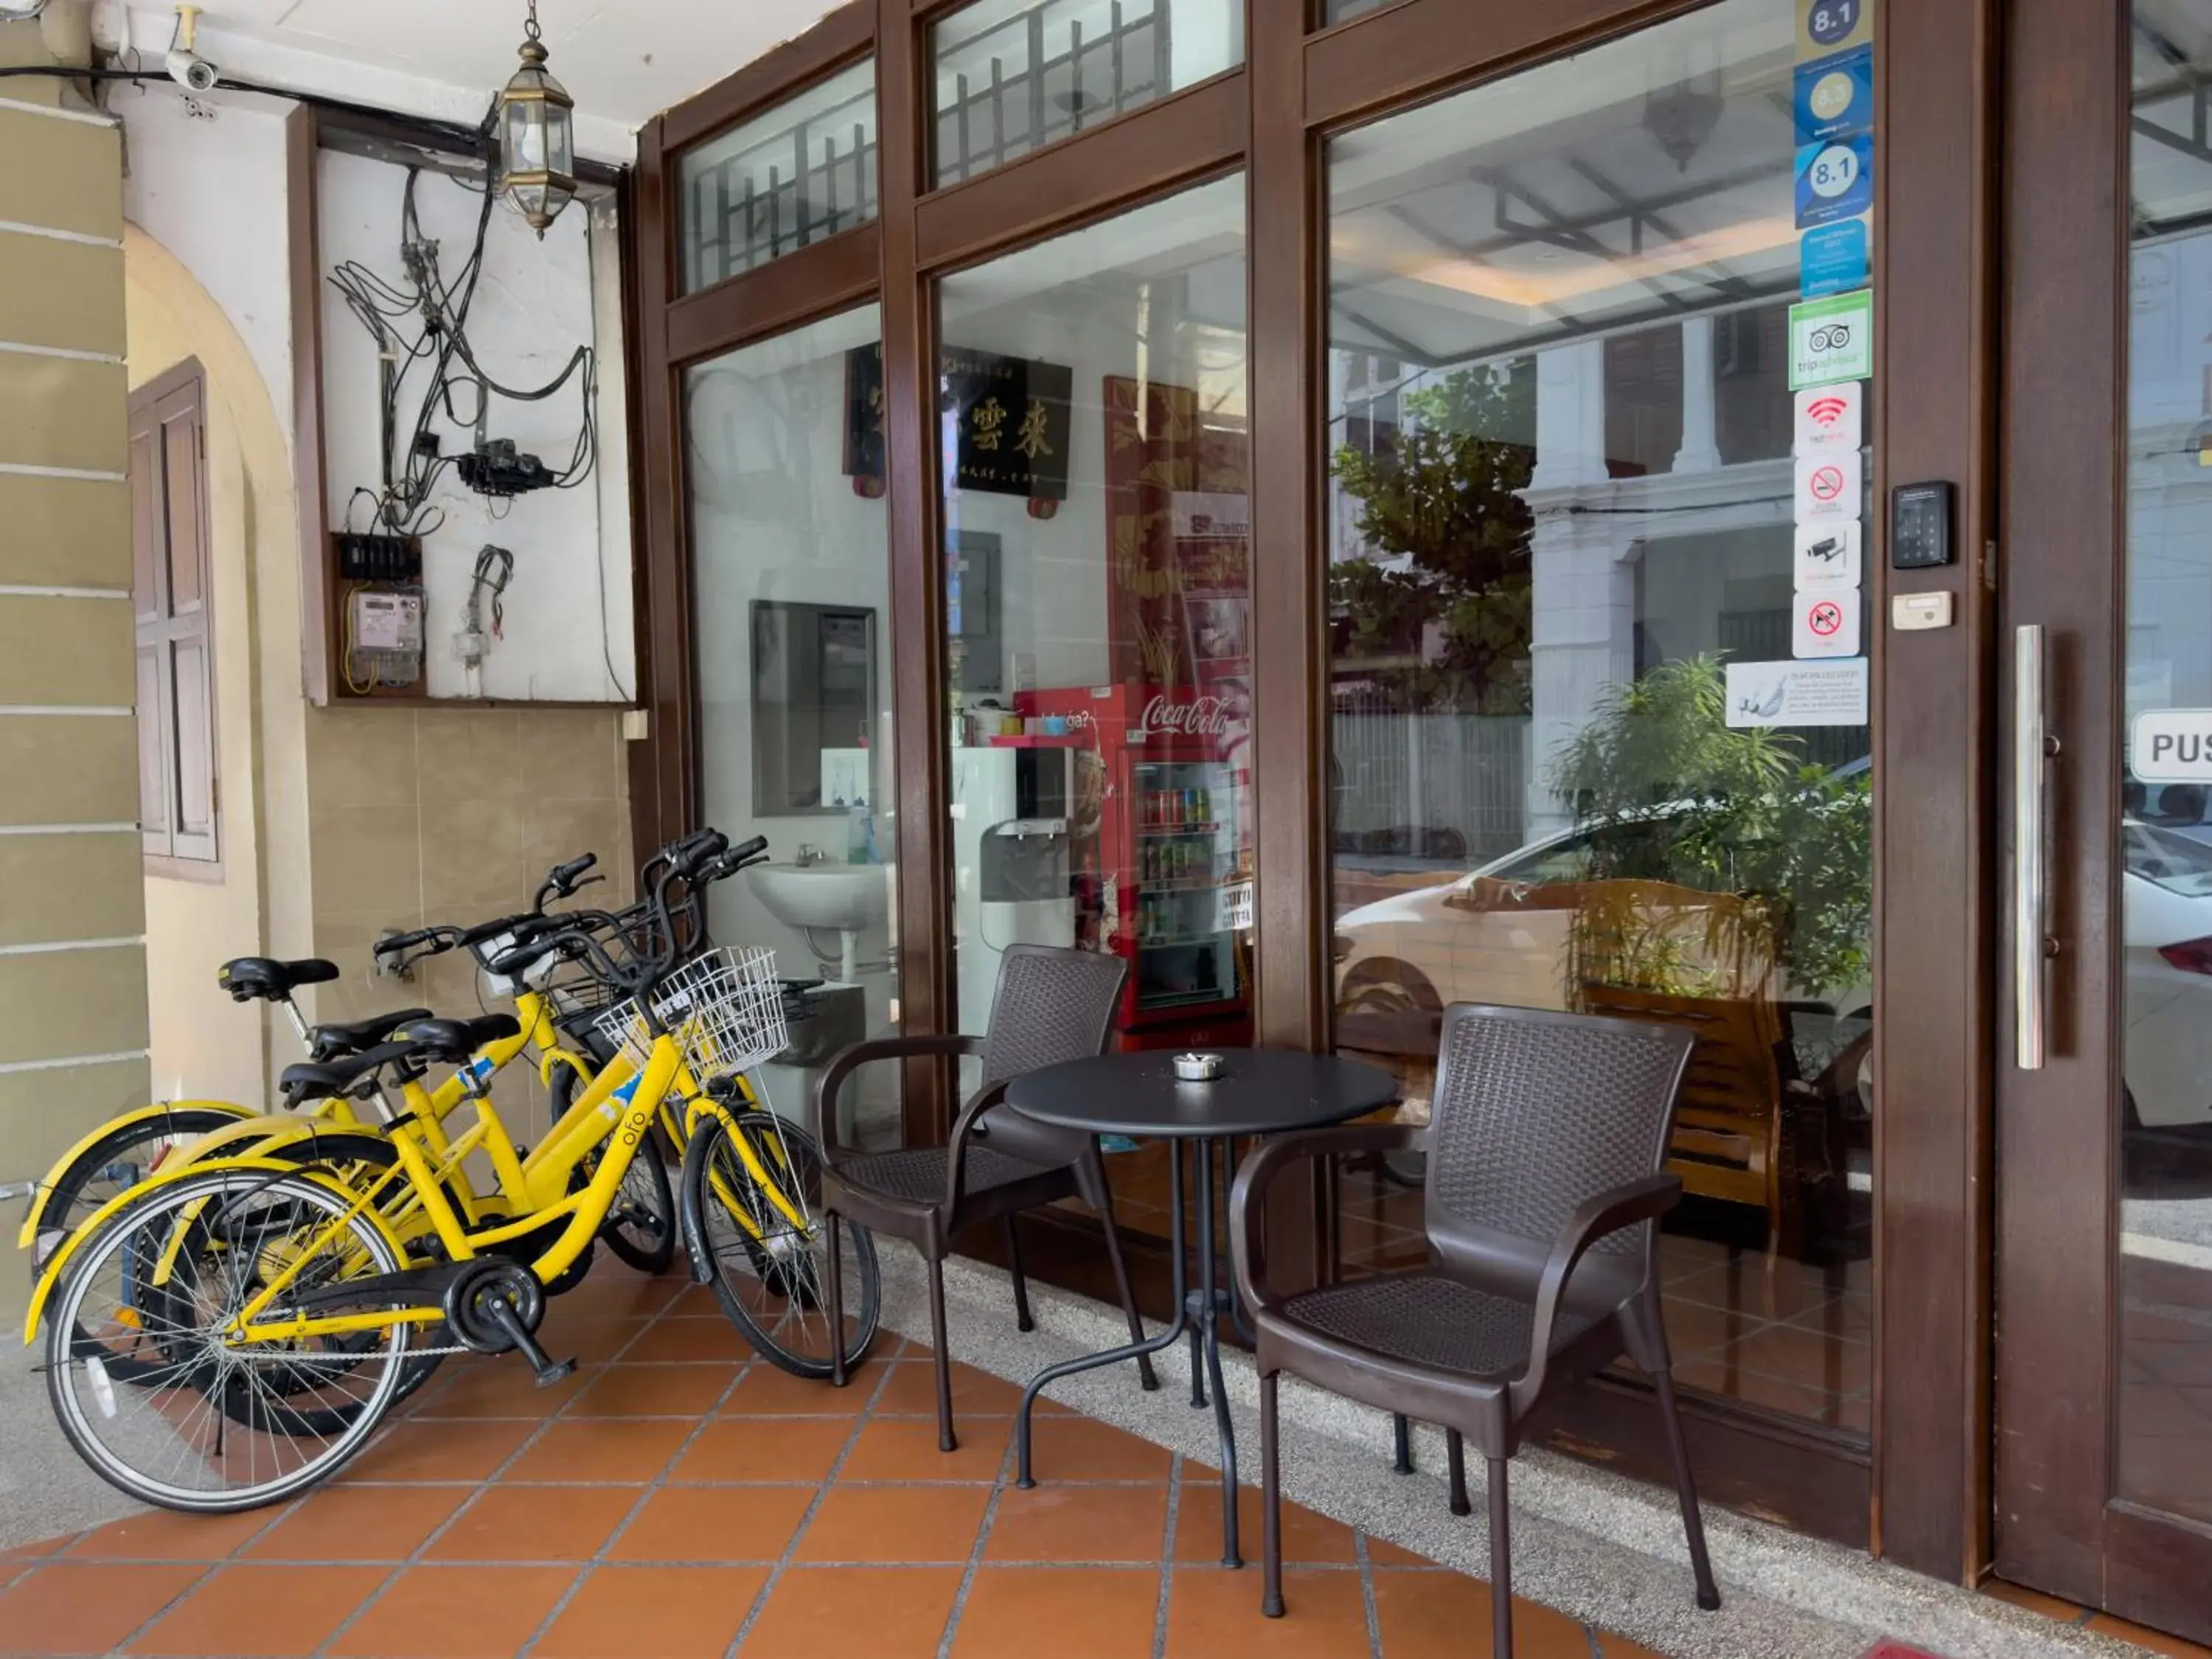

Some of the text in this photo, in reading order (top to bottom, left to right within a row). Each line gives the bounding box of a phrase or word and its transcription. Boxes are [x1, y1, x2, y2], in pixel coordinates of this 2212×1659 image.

[1815, 2, 1851, 32] 8.1
[1816, 156, 1849, 184] 8.1
[623, 1113, 645, 1145] ofo
